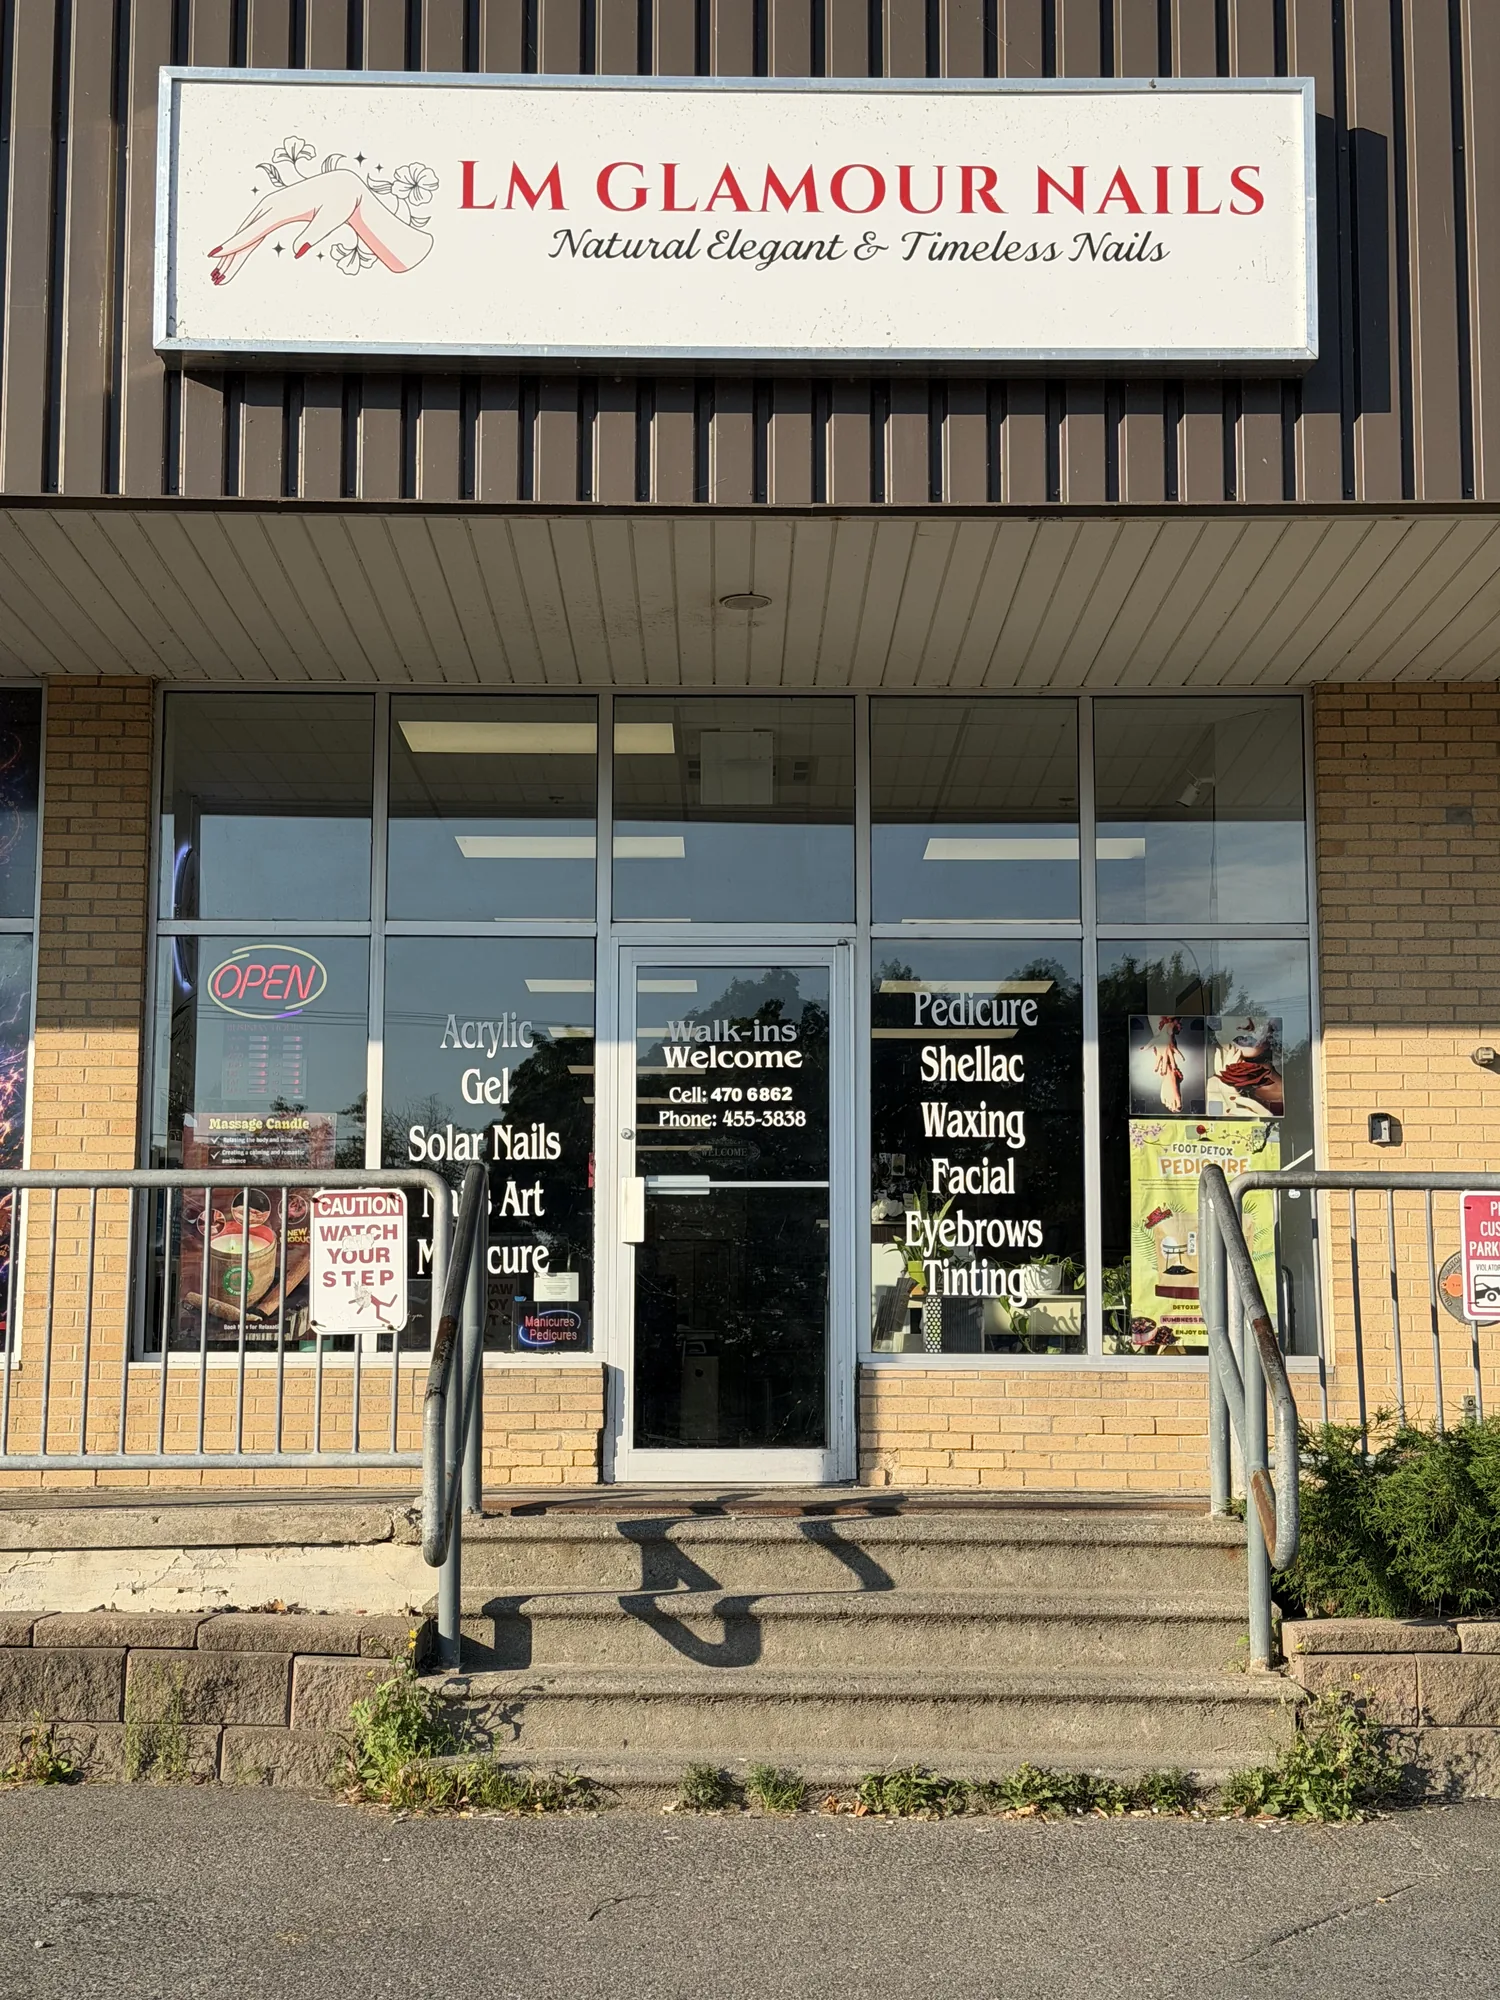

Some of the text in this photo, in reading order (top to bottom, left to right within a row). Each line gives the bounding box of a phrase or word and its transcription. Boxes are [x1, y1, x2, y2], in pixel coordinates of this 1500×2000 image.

[457, 160, 1265, 215] LM GLAMOUR NAILS
[549, 229, 1169, 270] Natural Elegant & Timeless Nails
[213, 964, 315, 1000] OPEN
[914, 991, 1038, 1027] Pedicure
[440, 1012, 533, 1058] Acrylic
[667, 1019, 798, 1043] Walk-ins
[663, 1046, 802, 1068] Welcome
[921, 1045, 1024, 1082] Shellac
[462, 1067, 509, 1104] Gel
[669, 1086, 792, 1104] Cell: 470 6862
[209, 1119, 310, 1133] Massage Candle
[659, 1110, 806, 1128] Phone: 455-3838
[921, 1101, 1025, 1148] Waxing
[409, 1123, 561, 1161] Solar Nails
[701, 1148, 748, 1157] WELCOME
[1173, 1143, 1233, 1156] FOOT DETOX
[932, 1157, 1015, 1194] Facial
[318, 1196, 399, 1215] CAUTION
[500, 1181, 544, 1216] Art
[288, 1227, 307, 1237] NEW
[319, 1224, 398, 1242] WATCH
[905, 1210, 1043, 1256] Eyebrows
[327, 1247, 391, 1264] YOUR
[417, 1238, 550, 1274] Mcure
[323, 1270, 394, 1287] STEP
[923, 1258, 1027, 1307] Tinting
[524, 1315, 575, 1327] Manicures
[529, 1329, 577, 1341] Pedicures
